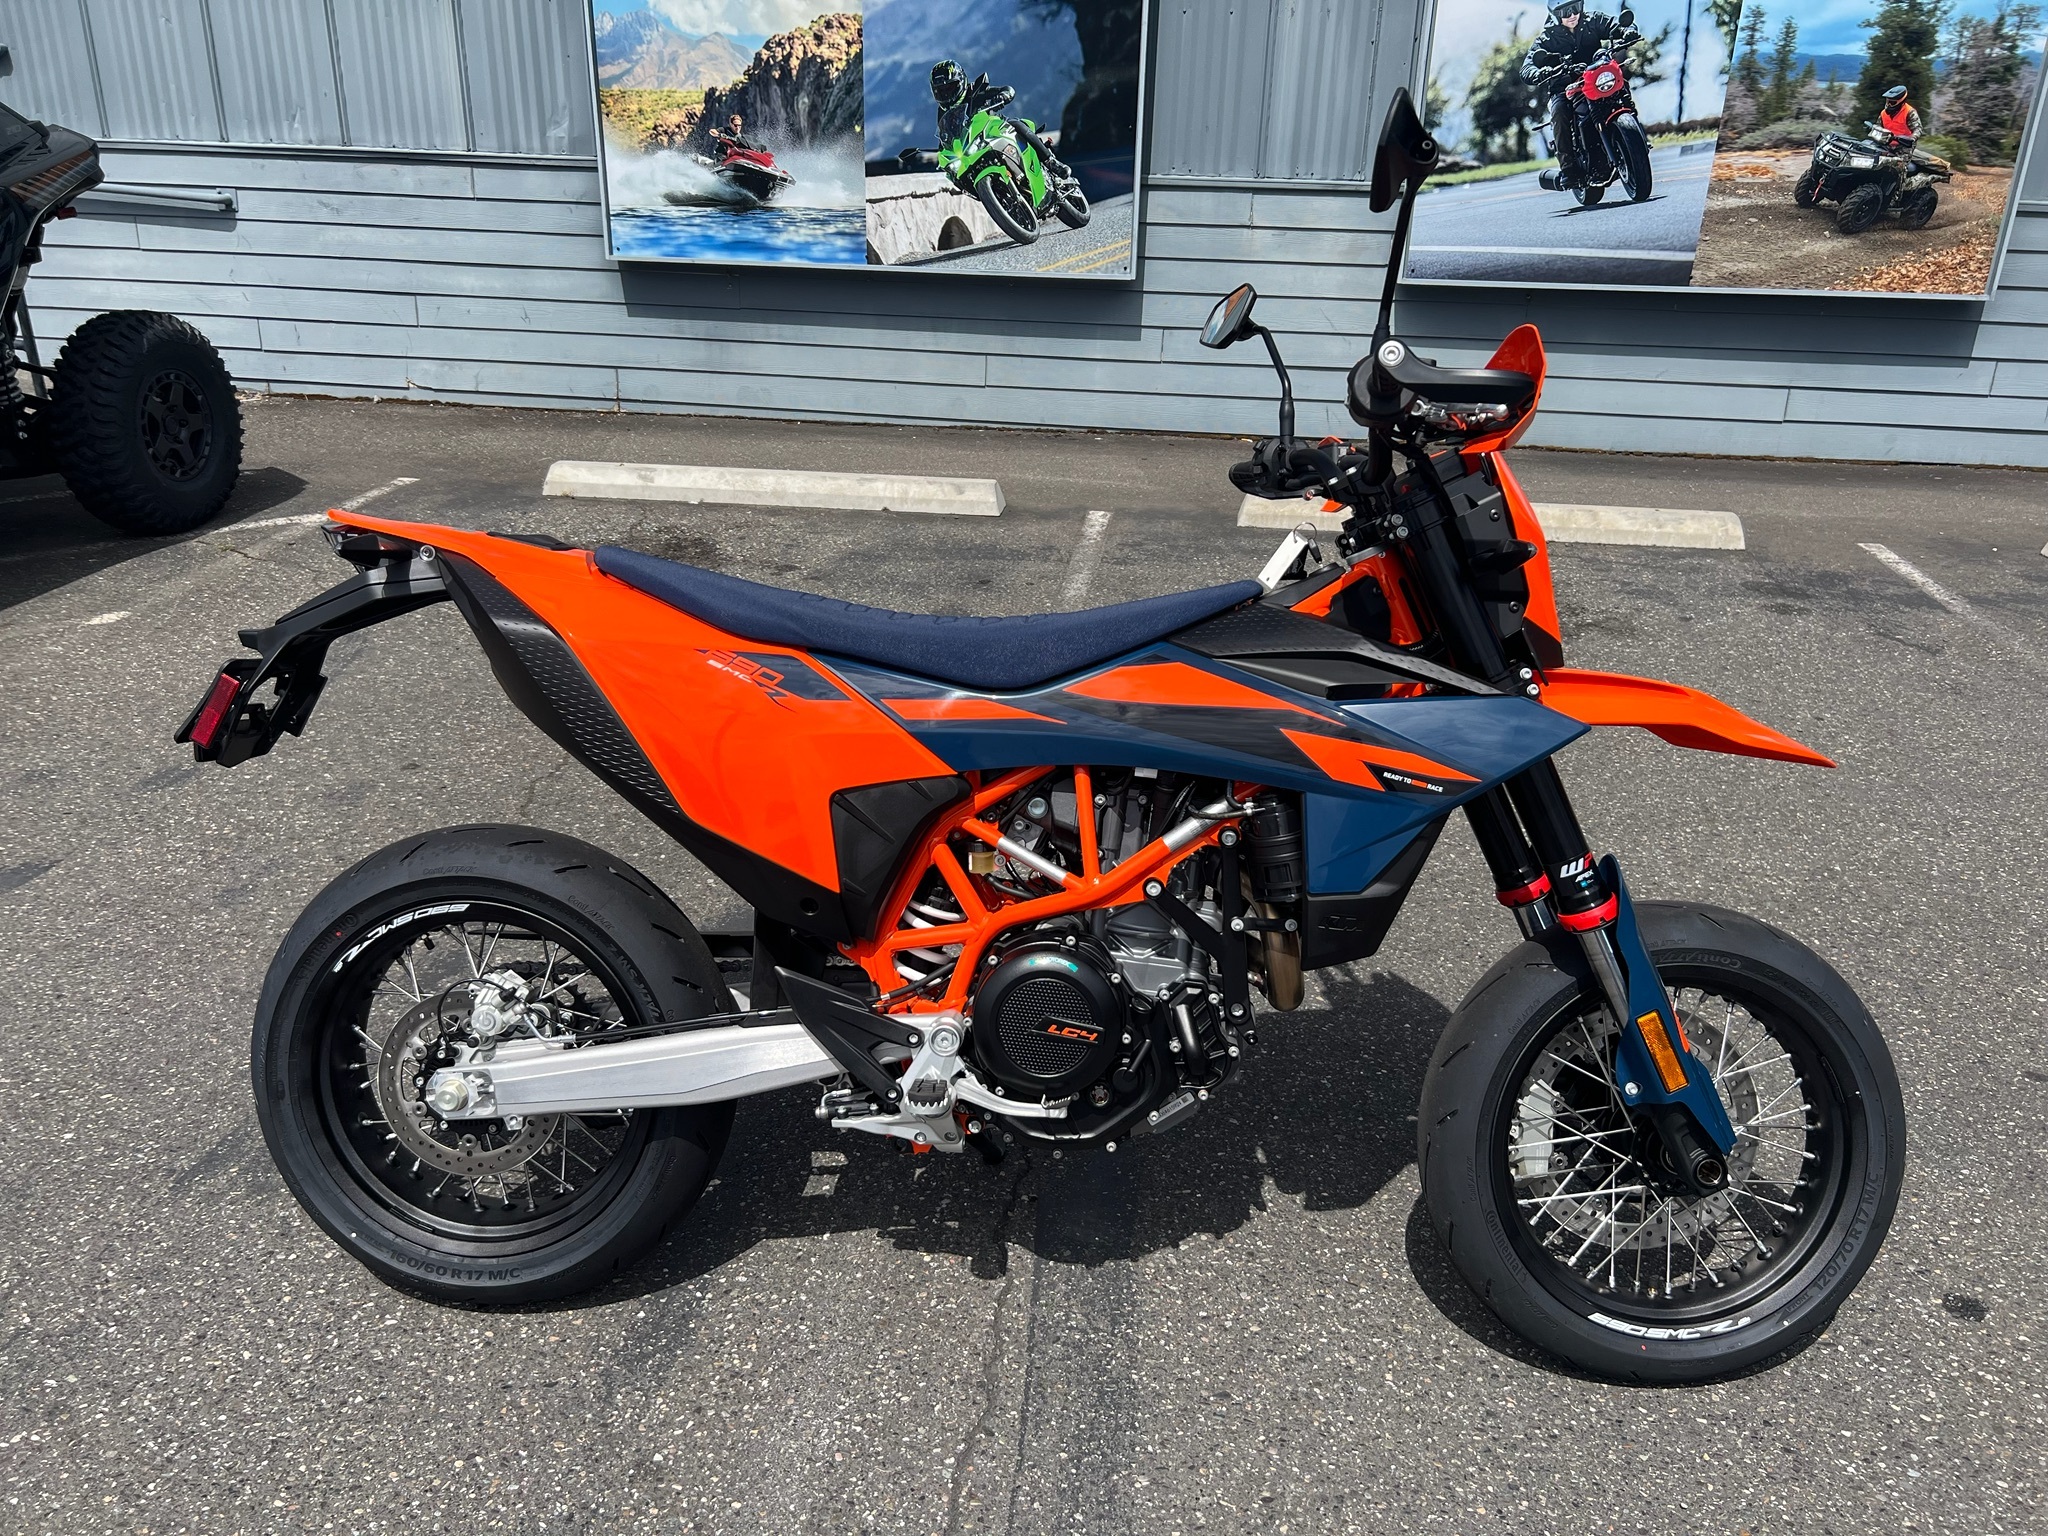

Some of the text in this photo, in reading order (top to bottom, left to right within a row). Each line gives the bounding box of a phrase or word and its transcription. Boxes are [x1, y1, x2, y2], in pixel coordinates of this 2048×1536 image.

[1383, 771, 1444, 793] READY TO RACE
[1047, 1024, 1098, 1041] LC4
[1812, 1240, 1856, 1291] 120/70
[1864, 1172, 1880, 1206] M/C
[389, 1252, 448, 1278] 160/60
[488, 1267, 521, 1281] M/C
